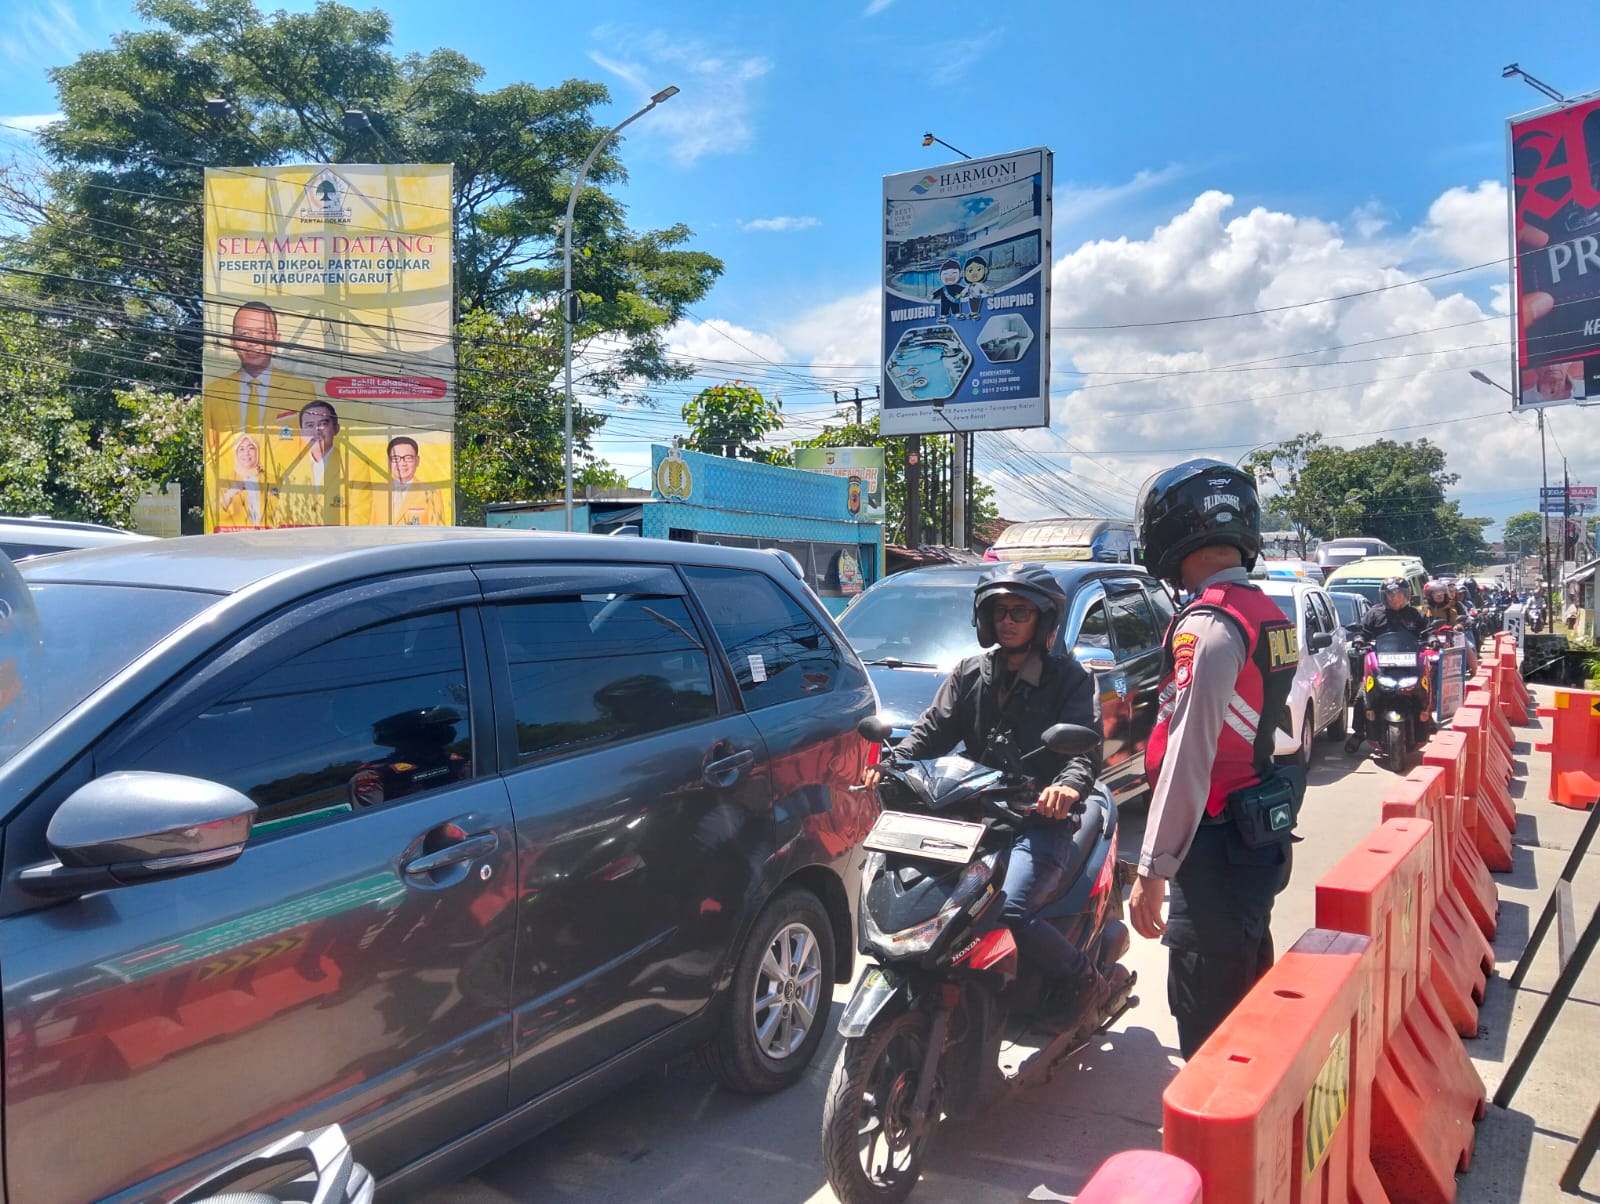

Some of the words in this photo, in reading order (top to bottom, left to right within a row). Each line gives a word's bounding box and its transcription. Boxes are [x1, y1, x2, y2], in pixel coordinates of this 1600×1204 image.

[940, 161, 1017, 187] HARMONI
[217, 236, 325, 256] SELAMAT
[332, 234, 434, 254] DATANG
[218, 260, 273, 271] PESERTA
[277, 259, 324, 271] DIKPOL
[328, 259, 372, 270] PARTAI
[376, 258, 431, 270] GOLKAR
[253, 273, 266, 284] DI
[269, 272, 345, 284] KABUPATEN
[348, 272, 393, 284] GARUT
[986, 292, 1034, 310] SUMPING
[890, 305, 936, 323] WILUJENG
[1207, 478, 1232, 486] RSV
[950, 936, 983, 962] HONDA
